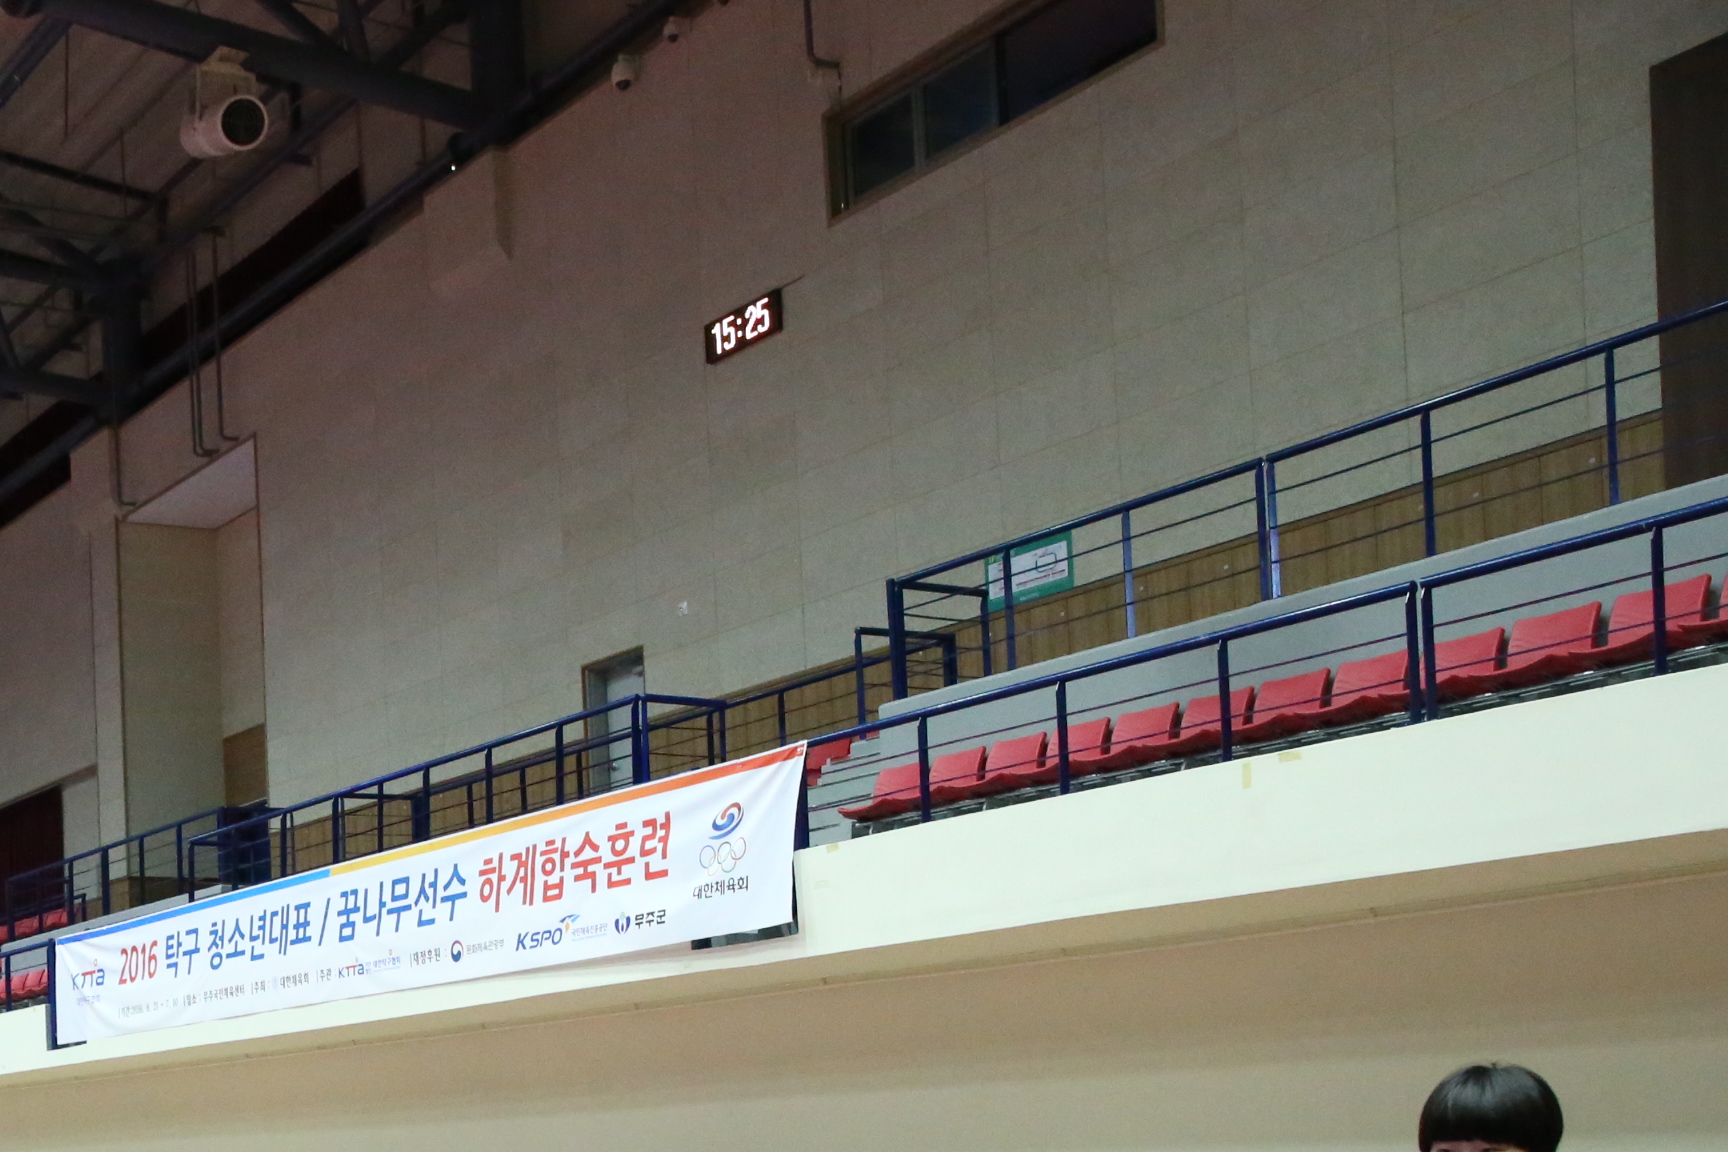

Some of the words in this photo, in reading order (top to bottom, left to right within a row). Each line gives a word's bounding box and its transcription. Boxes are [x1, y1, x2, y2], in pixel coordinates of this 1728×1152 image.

[711, 297, 770, 355] 15:25
[118, 939, 158, 985] 2016
[165, 928, 200, 978] 탁구
[208, 902, 312, 970] 청소년대표
[337, 863, 468, 943] 꿈나무선수
[478, 811, 671, 912] 하계합숙훈련
[693, 875, 749, 899] 대한체육회
[634, 909, 666, 930] 무주군
[515, 927, 563, 951] KSPO
[413, 947, 441, 966] 재정후원
